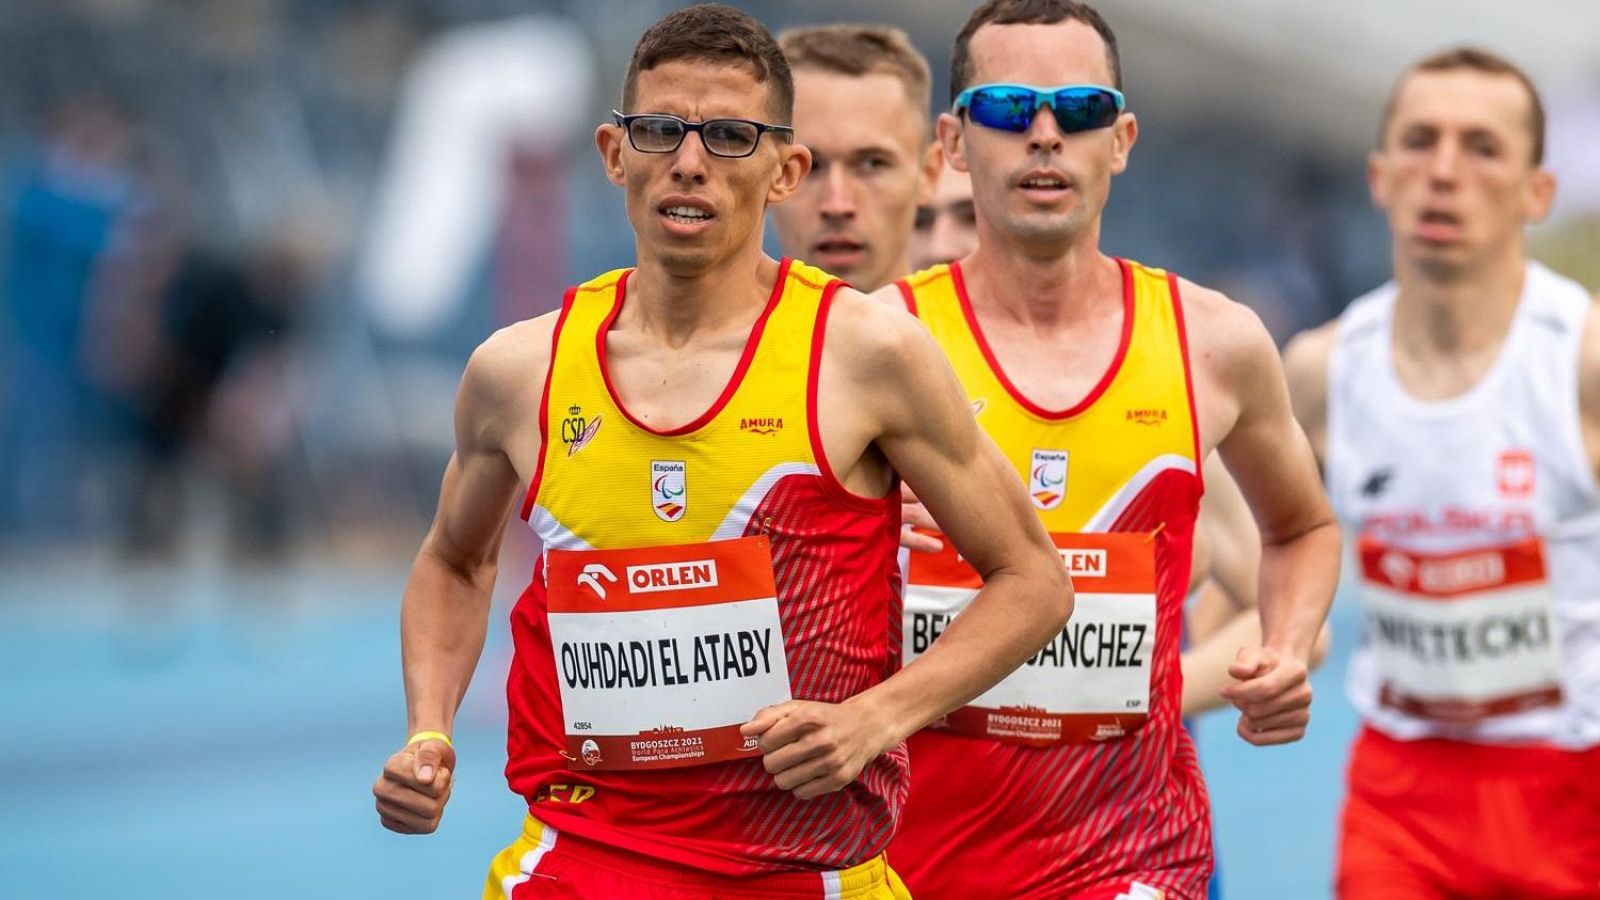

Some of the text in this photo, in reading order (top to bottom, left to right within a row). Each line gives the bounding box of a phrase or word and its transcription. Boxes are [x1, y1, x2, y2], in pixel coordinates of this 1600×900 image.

[1126, 409, 1167, 421] AMURA
[740, 418, 783, 430] AMURA
[562, 418, 586, 443] CSD
[653, 463, 683, 473] España
[632, 565, 712, 589] ORLEN
[1026, 623, 1146, 668] ANCHEZ
[561, 628, 771, 689] OUHDADI EL ATABY
[1126, 700, 1141, 708] ESP
[574, 722, 592, 730] 42854
[630, 737, 703, 750] BYDGOSZCZ 2021
[632, 751, 705, 762] European Championships
